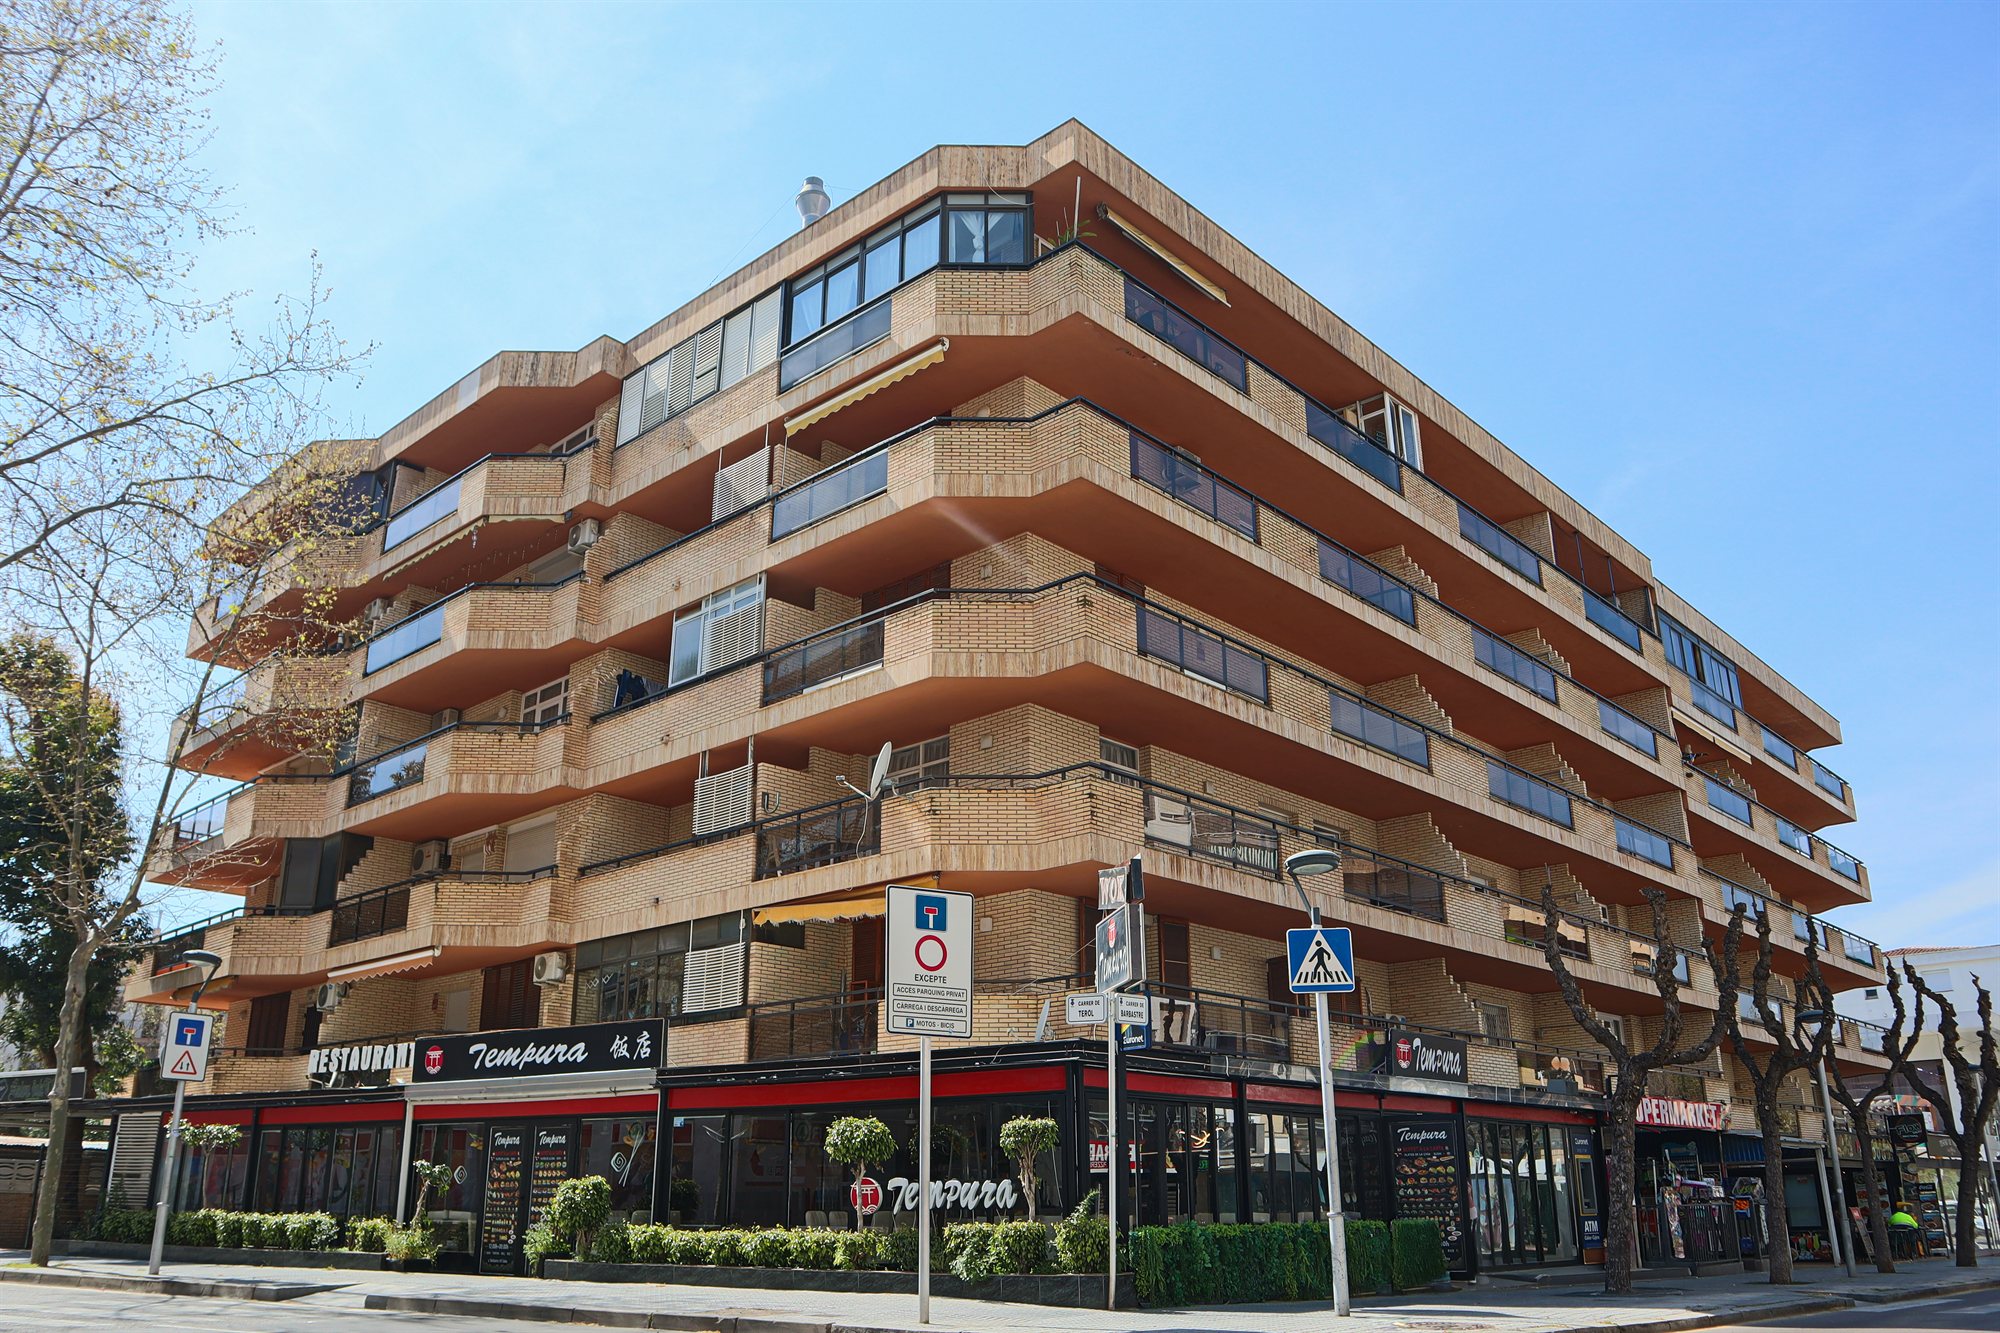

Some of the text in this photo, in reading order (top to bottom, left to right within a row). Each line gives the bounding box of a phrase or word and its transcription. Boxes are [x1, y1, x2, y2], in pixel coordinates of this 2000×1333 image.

[1099, 873, 1125, 905] WOK
[914, 973, 947, 984] EXCEPTE
[916, 988, 945, 996] PARQUING
[945, 990, 965, 998] PRIVAT
[1078, 1009, 1094, 1018] TEROL
[1120, 1009, 1144, 1019] BARBASTRE
[916, 1020, 936, 1028] MOTOS
[609, 1031, 652, 1061] 饭店
[1122, 1035, 1144, 1045] Euronet
[468, 1041, 589, 1070] Tempura
[1412, 1037, 1462, 1077] Tempura
[1636, 1098, 1718, 1129] UPERMARKET
[494, 1132, 520, 1149] Tempura
[539, 1131, 567, 1148] Tempura
[1397, 1127, 1447, 1144] Tempura
[1584, 1220, 1599, 1233] ATM
